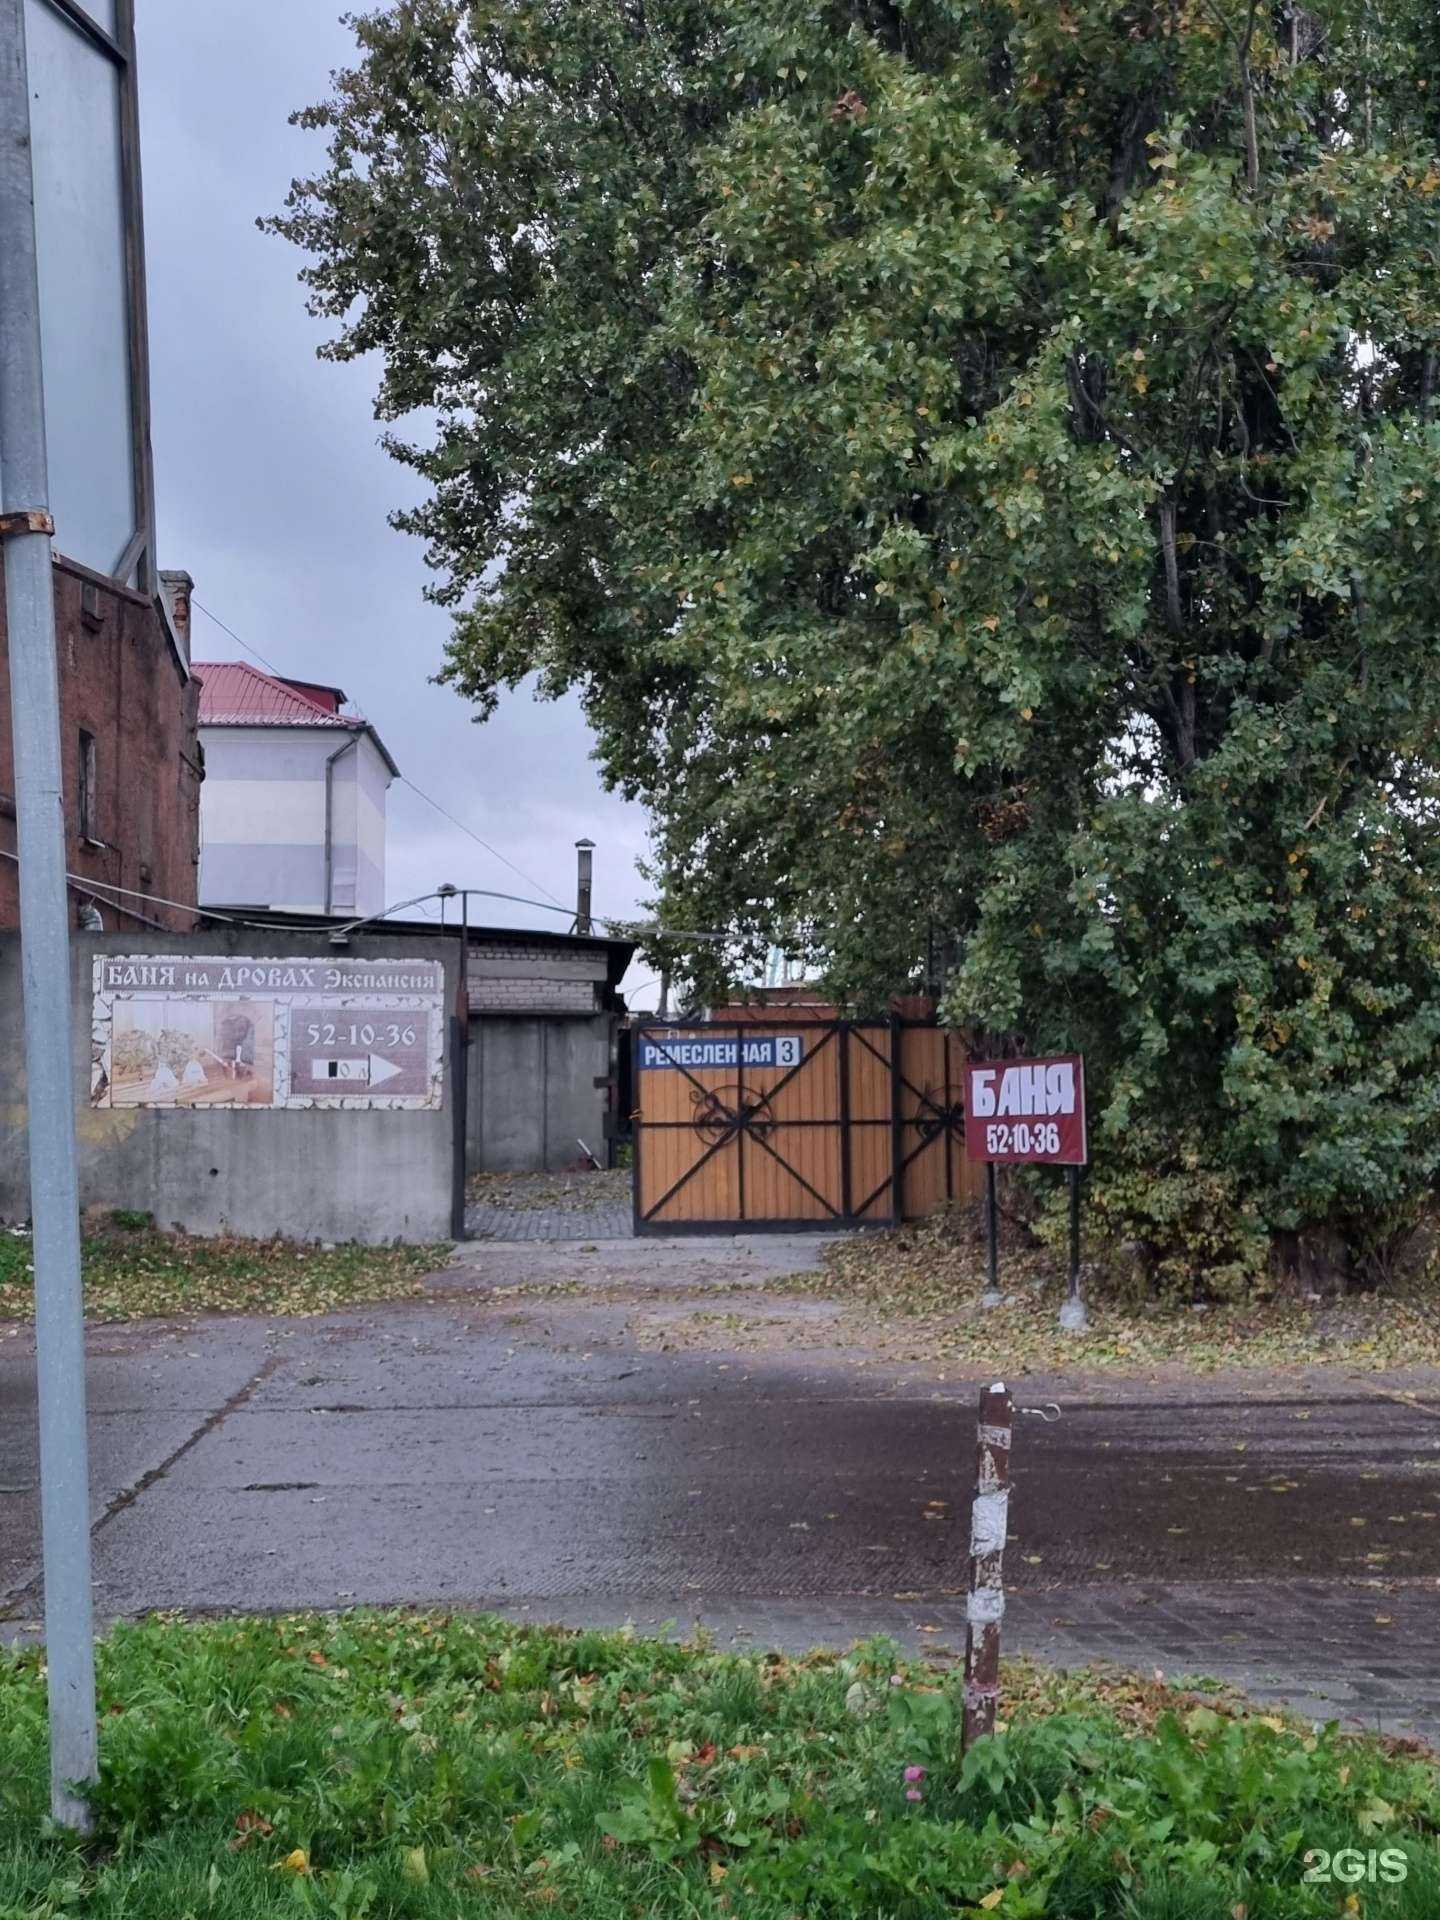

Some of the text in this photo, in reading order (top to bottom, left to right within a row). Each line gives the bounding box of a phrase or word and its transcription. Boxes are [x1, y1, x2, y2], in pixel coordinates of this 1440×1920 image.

[108, 966, 434, 989] БАНЯ на ДРОВАХ Экспансия
[307, 1024, 416, 1047] 52-10-36
[781, 1040, 793, 1062] 3
[972, 1063, 1075, 1117] БАНЯ
